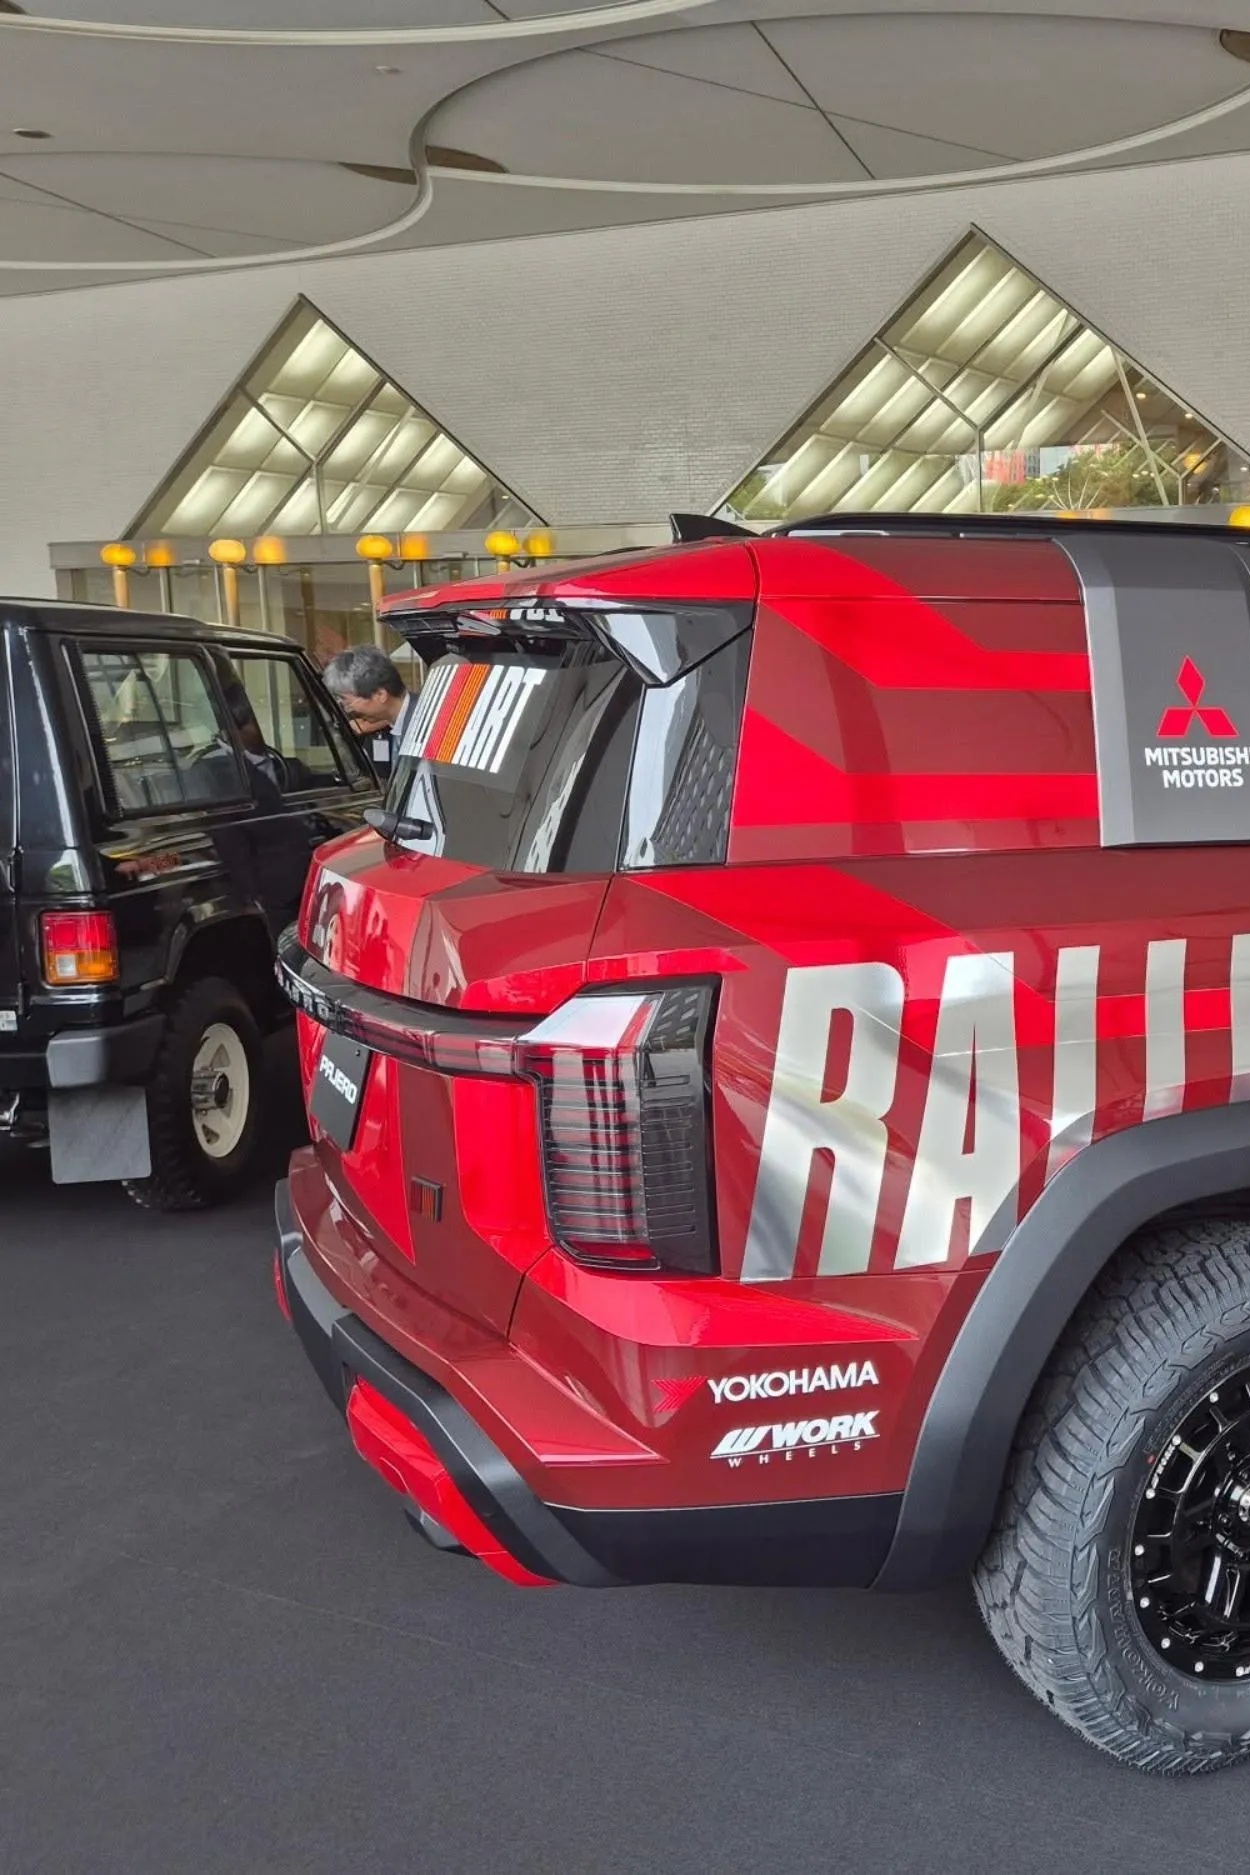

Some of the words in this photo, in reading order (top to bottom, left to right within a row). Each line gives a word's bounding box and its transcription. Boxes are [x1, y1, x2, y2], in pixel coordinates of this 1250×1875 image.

[1163, 769, 1244, 788] MOTORS
[319, 1054, 358, 1105] PAJERO
[707, 1361, 879, 1404] YOKOHAMA
[772, 1410, 881, 1448] WORK
[728, 1441, 863, 1468] WHEELS
